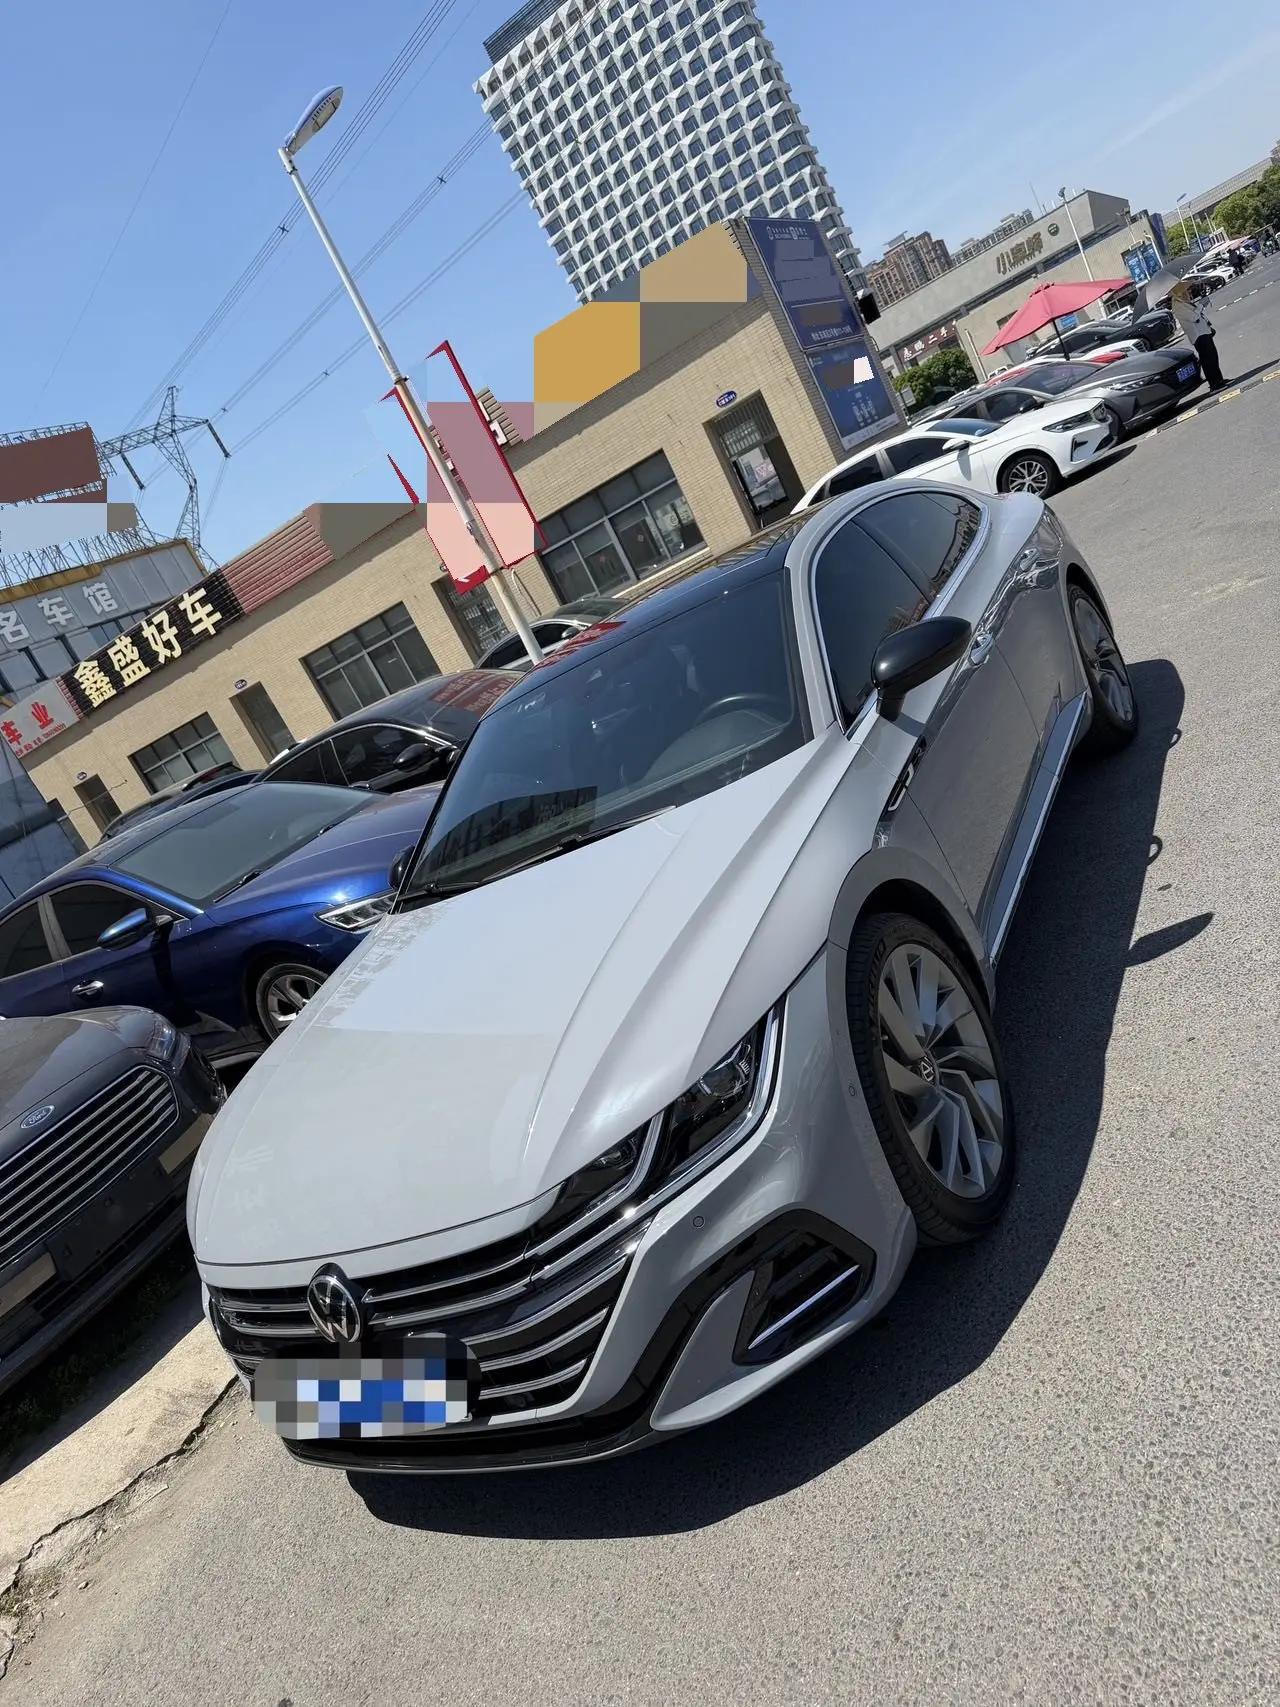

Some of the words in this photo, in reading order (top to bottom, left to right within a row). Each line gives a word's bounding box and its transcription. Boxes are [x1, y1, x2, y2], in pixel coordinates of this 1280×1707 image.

[0, 582, 117, 643] 名车馆
[73, 588, 222, 708] 鑫盛好车
